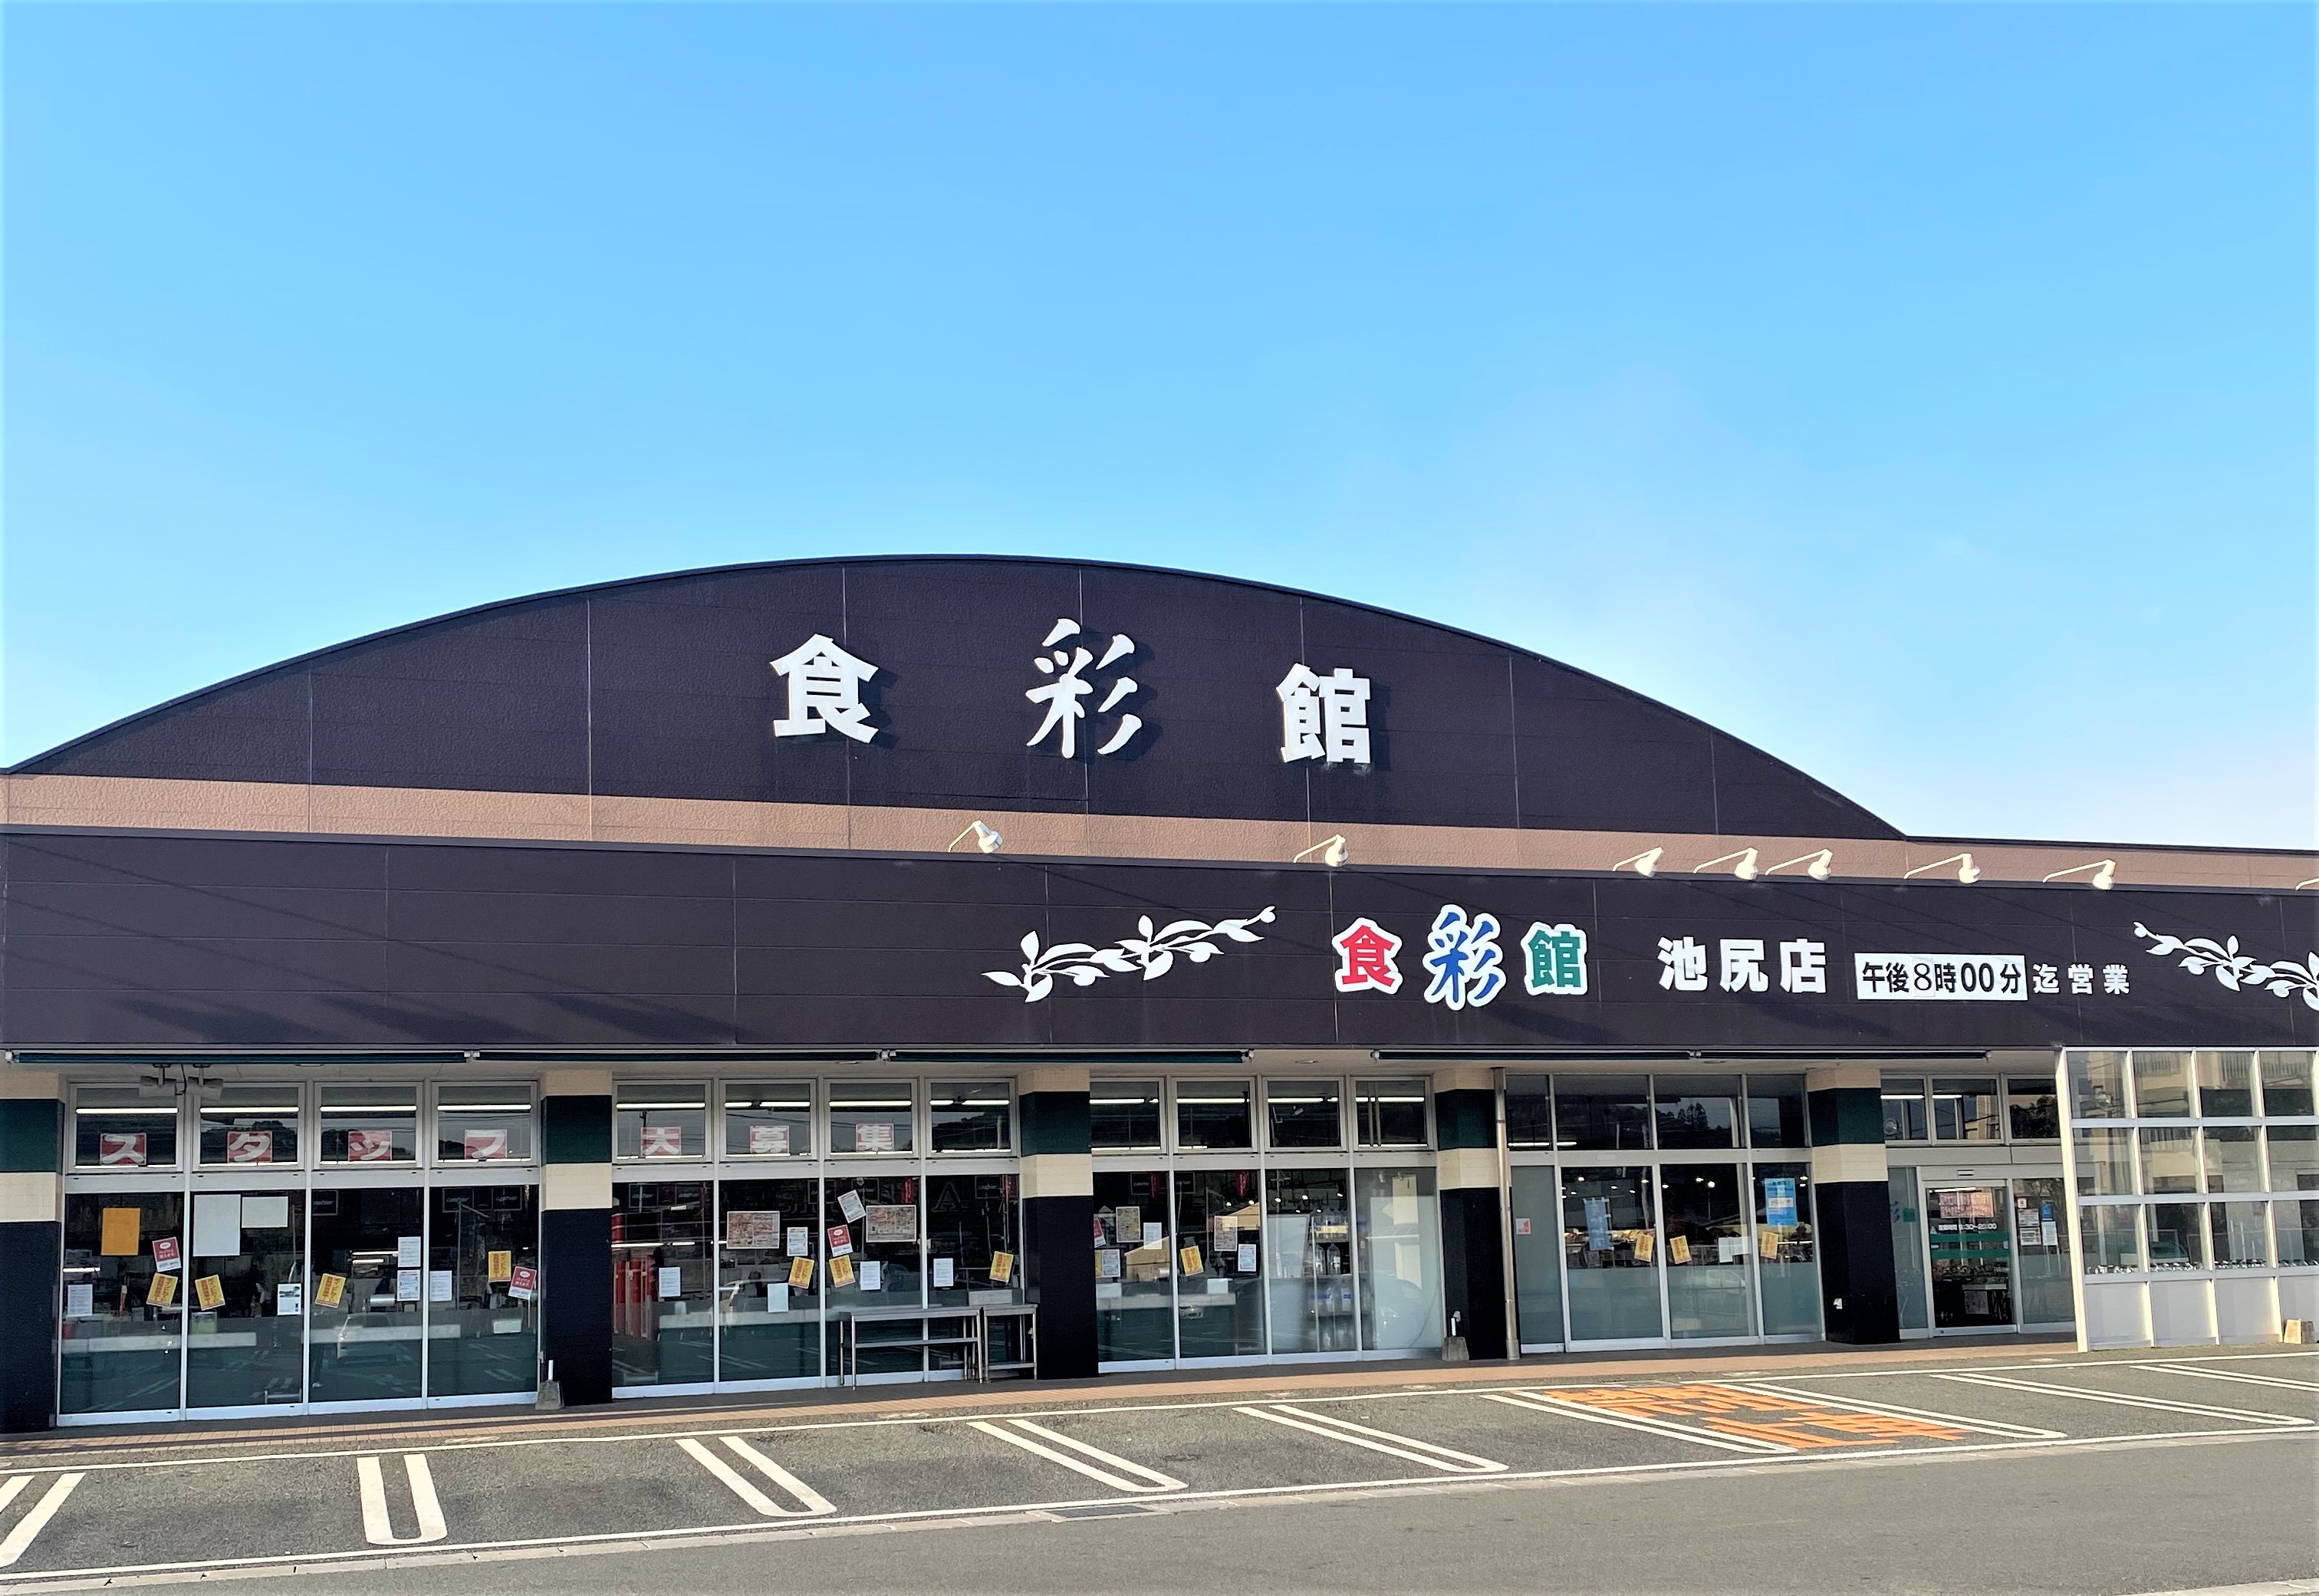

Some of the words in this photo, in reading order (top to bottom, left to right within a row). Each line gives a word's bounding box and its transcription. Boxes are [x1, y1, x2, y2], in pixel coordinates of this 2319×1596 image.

[769, 617, 1370, 764] 食彩館
[1332, 903, 1589, 1012] 食彩館
[1656, 936, 1827, 994] 池尻店
[1861, 960, 2025, 995] 午後8時00分
[2032, 963, 2133, 995] 迄営業
[101, 1130, 506, 1165] スタッフ
[642, 1124, 894, 1156] 大募集
